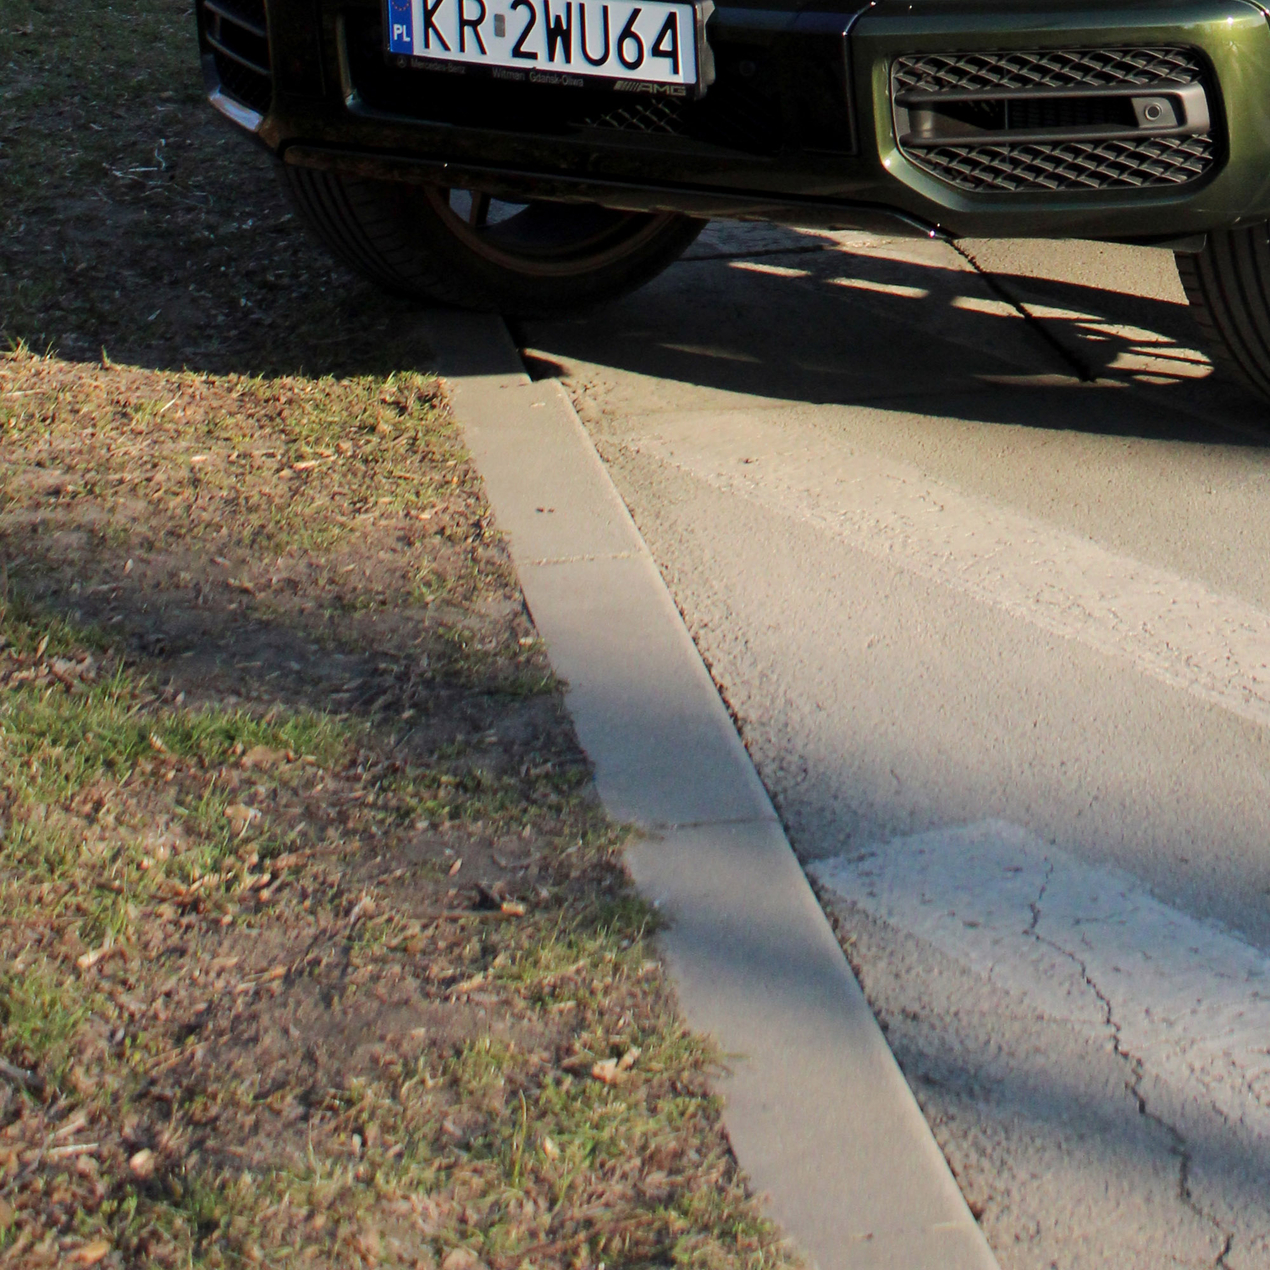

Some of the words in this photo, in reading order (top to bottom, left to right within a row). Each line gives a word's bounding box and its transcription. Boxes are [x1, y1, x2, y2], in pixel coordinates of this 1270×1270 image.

[393, 24, 410, 42] PL
[410, 58, 466, 75] Mercedes-Benz
[637, 83, 686, 97] AMG
